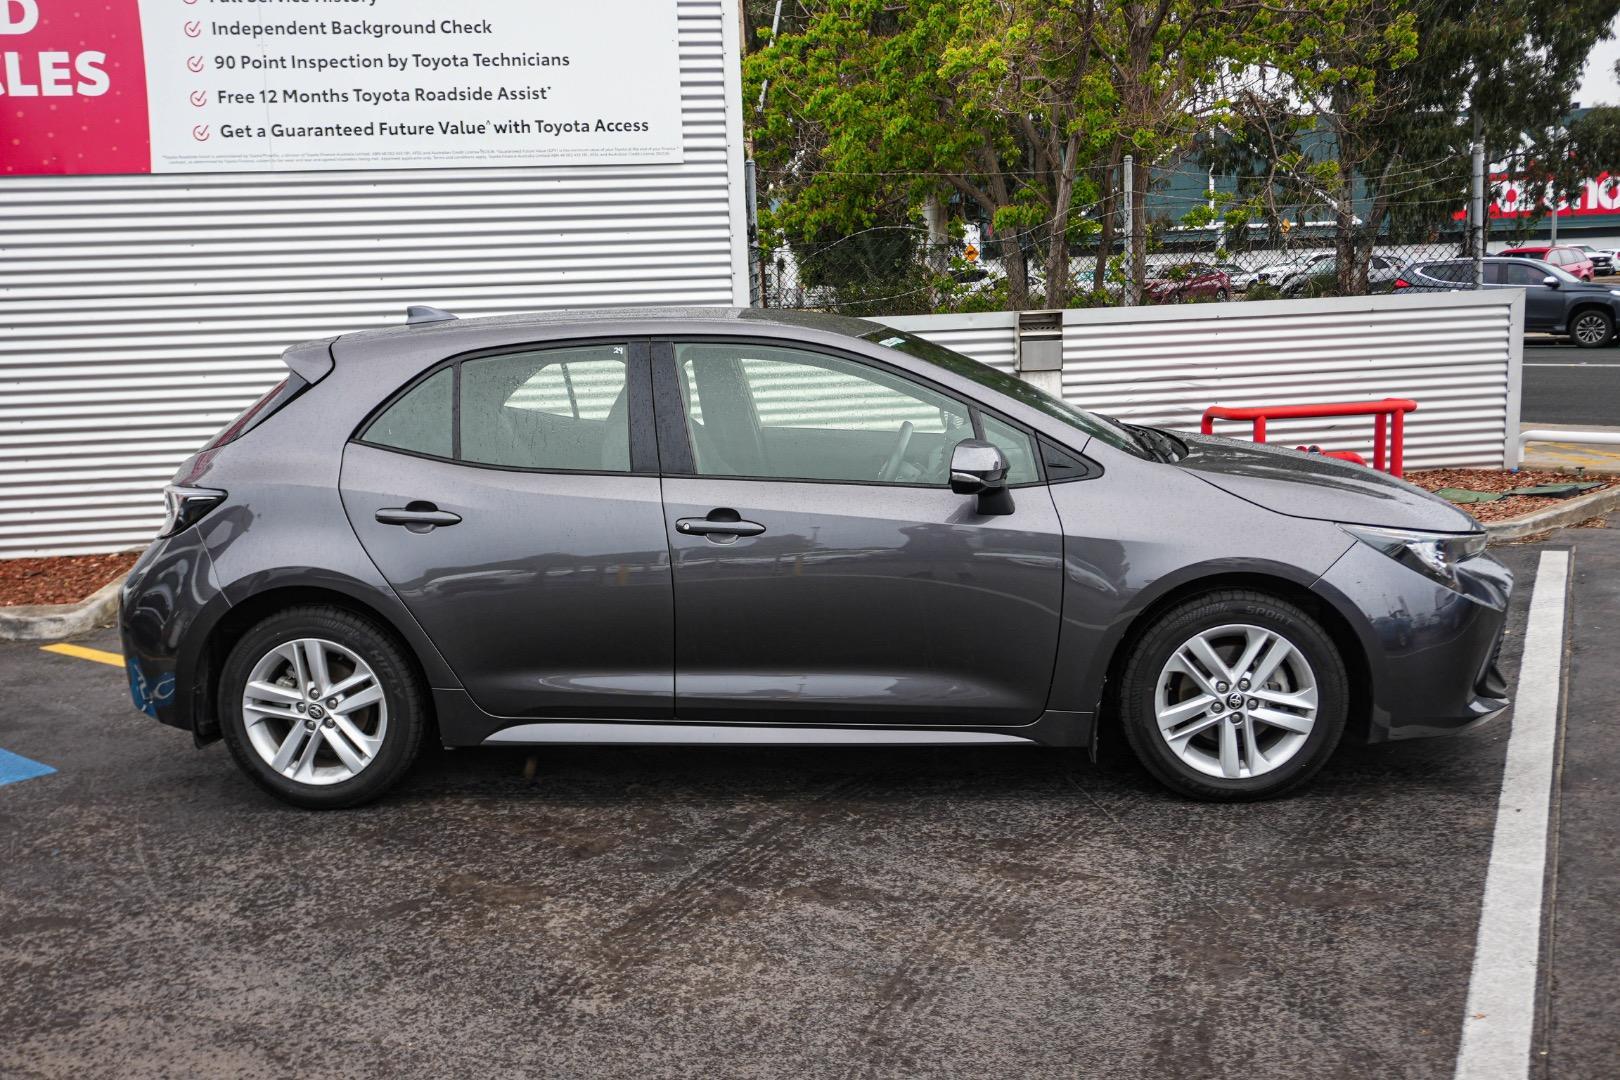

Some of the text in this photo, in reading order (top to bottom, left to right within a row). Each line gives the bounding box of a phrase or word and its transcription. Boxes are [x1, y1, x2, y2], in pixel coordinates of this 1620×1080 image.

[212, 19, 493, 39] Independent Background Check
[214, 52, 570, 73] 90 Point Inspection by Toyota Technicians
[0, 50, 111, 97] LES
[217, 90, 255, 104] Free
[259, 90, 278, 104] 12
[282, 88, 349, 104] Months
[353, 88, 410, 106] Toyota
[414, 86, 493, 102] Roadside
[220, 124, 253, 139] Get
[256, 127, 266, 138] a
[270, 121, 375, 138] Guaranteed
[378, 121, 434, 137] Future
[494, 119, 531, 134] with
[535, 119, 590, 137] Toyota
[594, 118, 649, 133] Access
